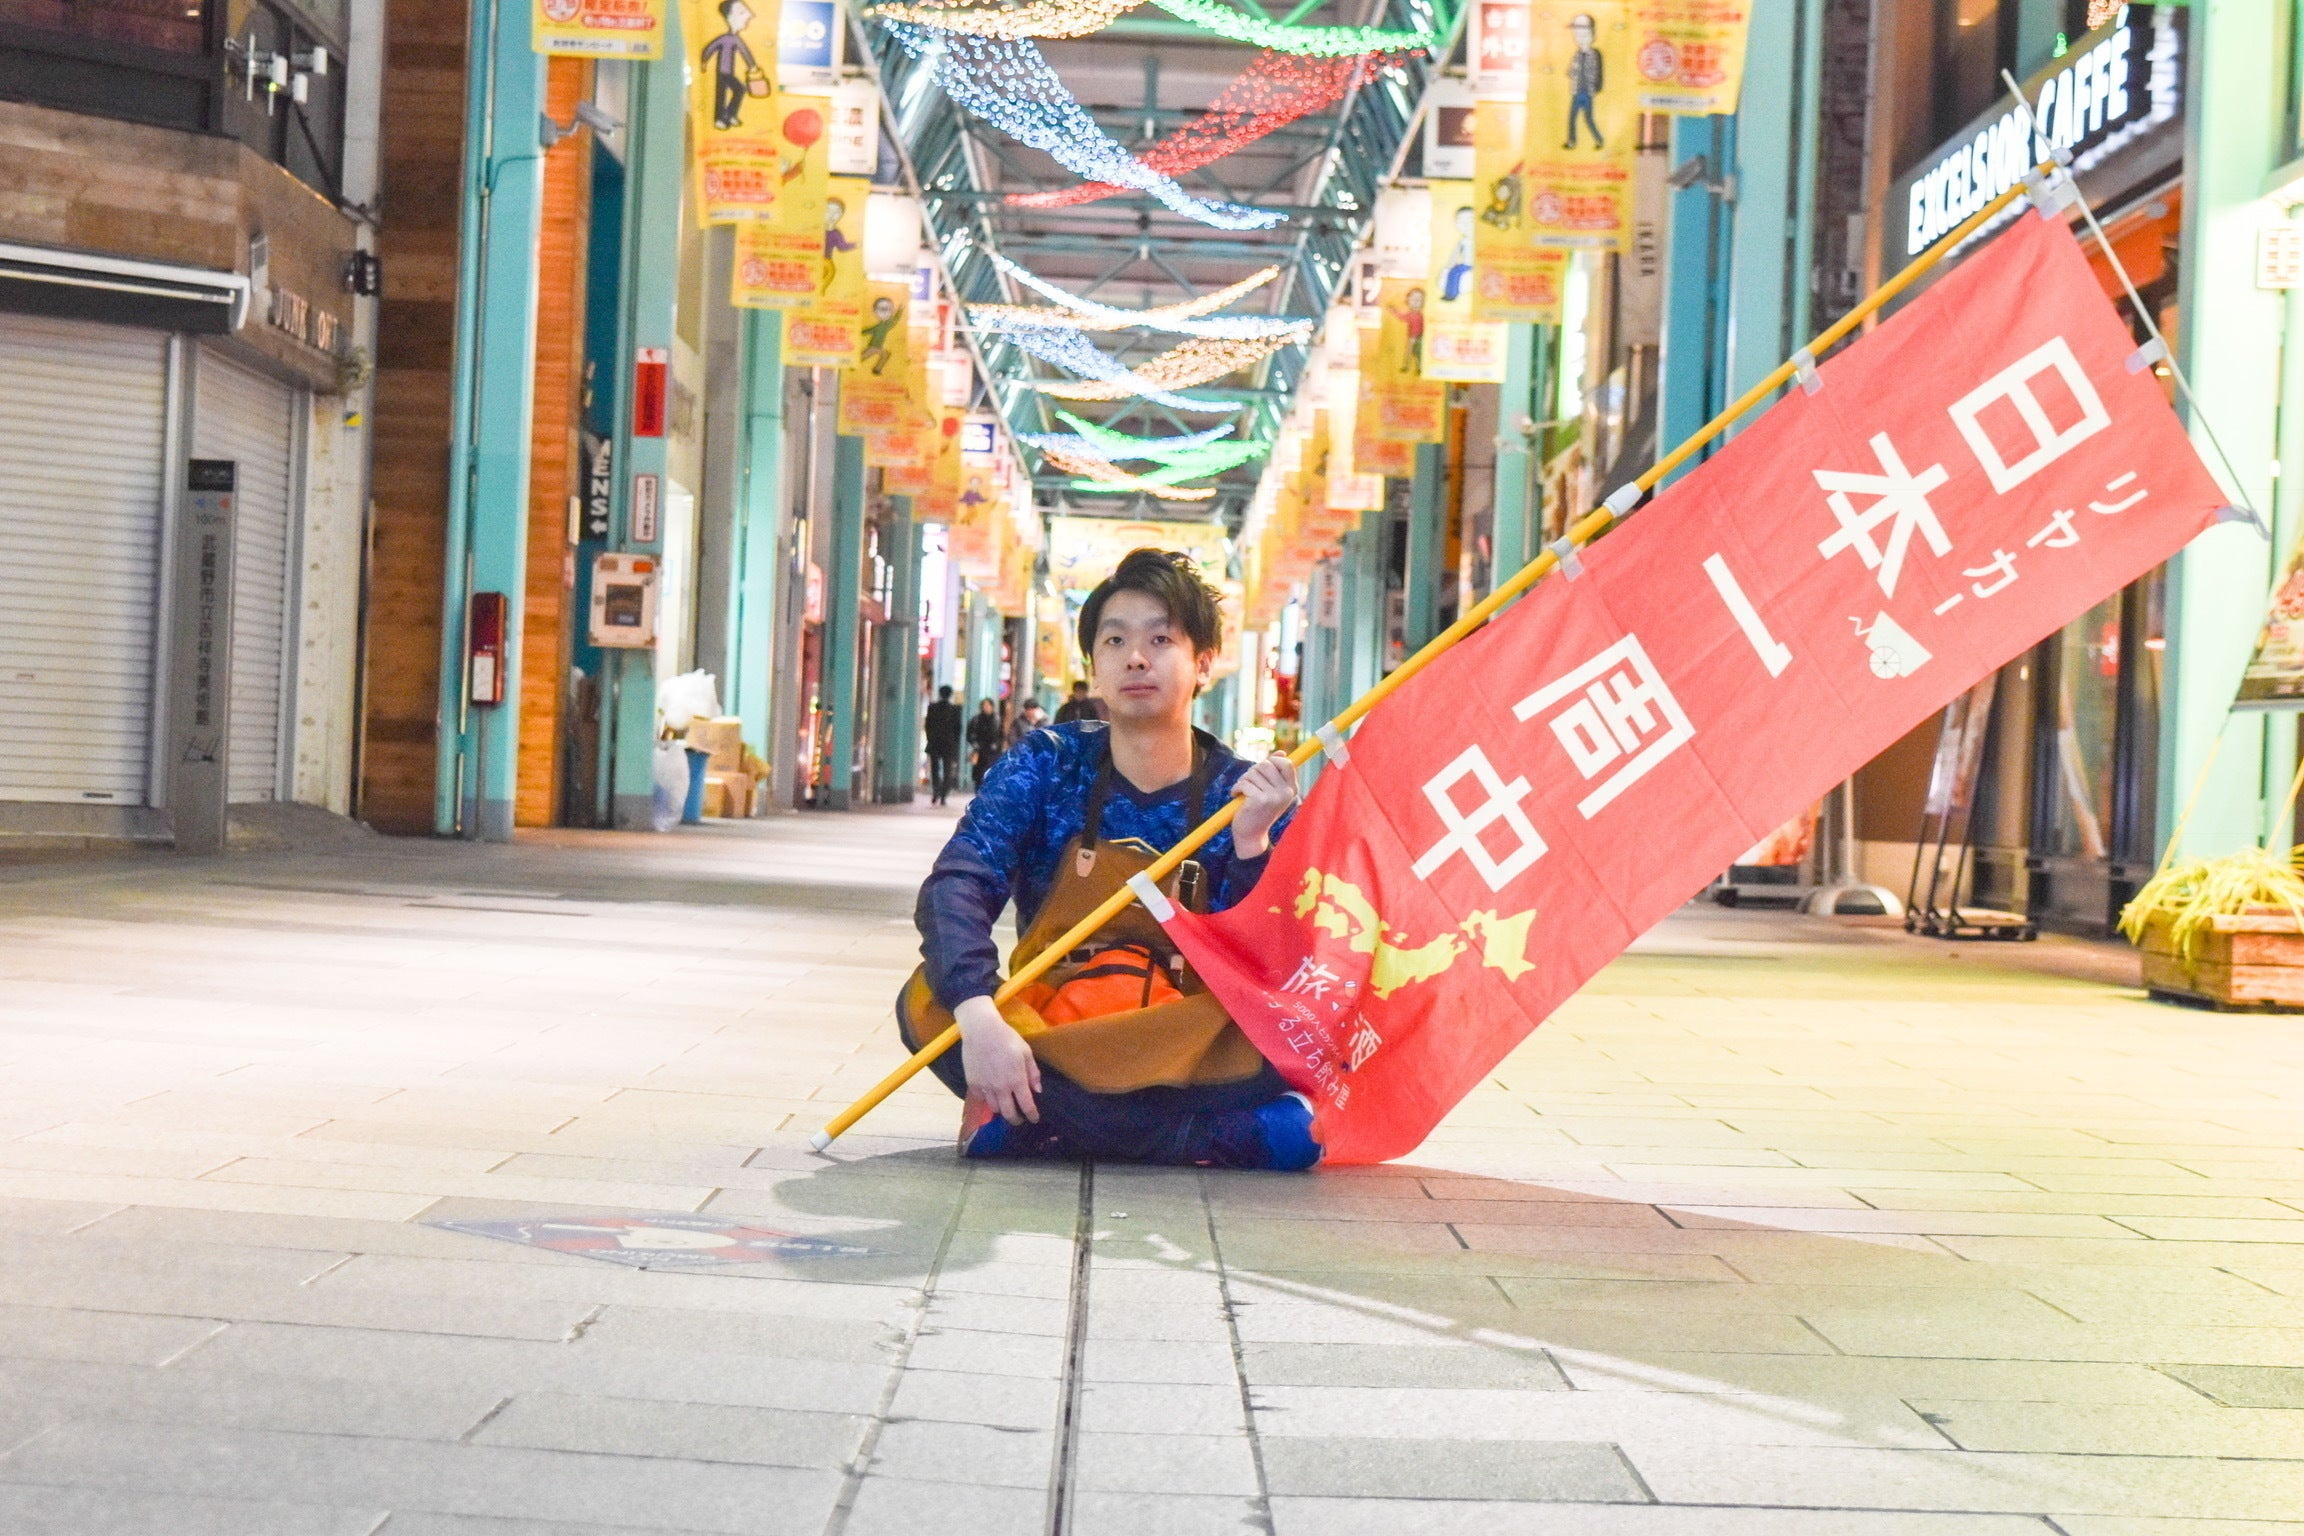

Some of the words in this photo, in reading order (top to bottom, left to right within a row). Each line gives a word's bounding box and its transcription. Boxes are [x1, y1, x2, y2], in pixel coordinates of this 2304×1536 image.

[1907, 104, 2032, 256] EXCELSIOR
[2034, 3, 2132, 165] CAFFÉ
[1411, 336, 2113, 894] 日本一周中
[1934, 471, 2149, 617] リヤカー
[1280, 954, 1340, 1001] 旅
[1348, 1012, 1383, 1073] 酒
